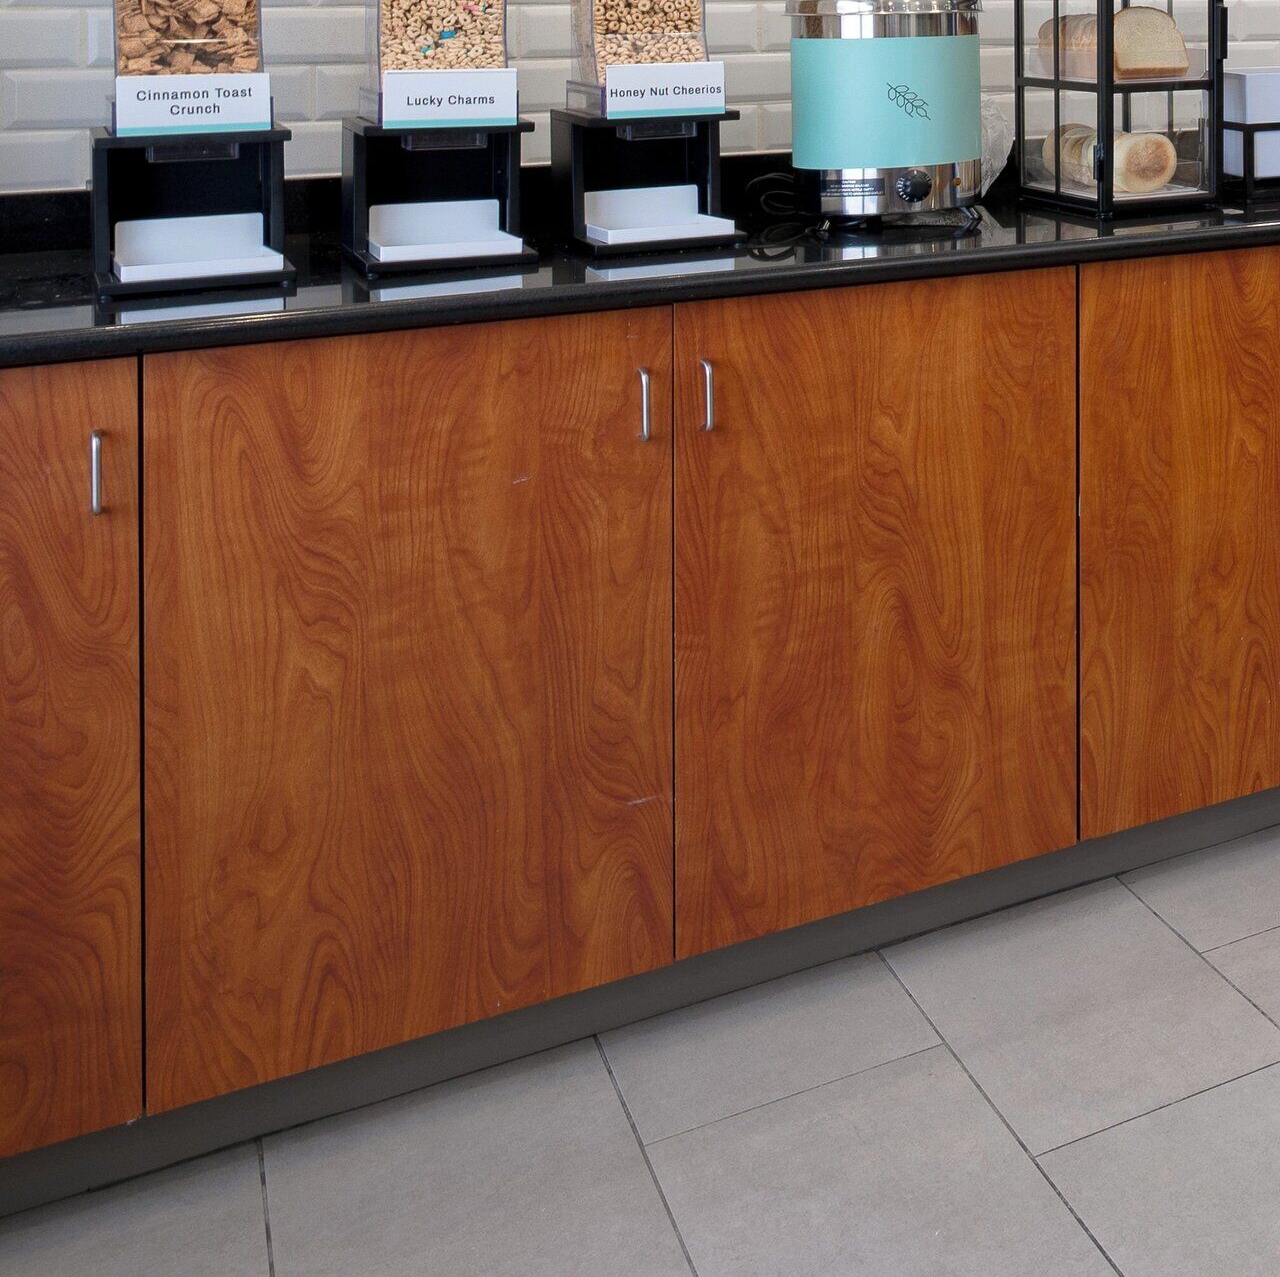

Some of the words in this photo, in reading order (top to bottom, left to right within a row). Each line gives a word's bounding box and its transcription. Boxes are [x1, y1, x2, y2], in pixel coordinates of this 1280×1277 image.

[136, 89, 209, 102] Cinnamon
[215, 87, 253, 98] Toast
[610, 88, 646, 99] Honey
[650, 86, 669, 96] Nut
[673, 84, 722, 96] Cheerios
[406, 95, 443, 108] Lucky
[448, 94, 495, 105] Charms
[170, 103, 221, 116] Crunch
